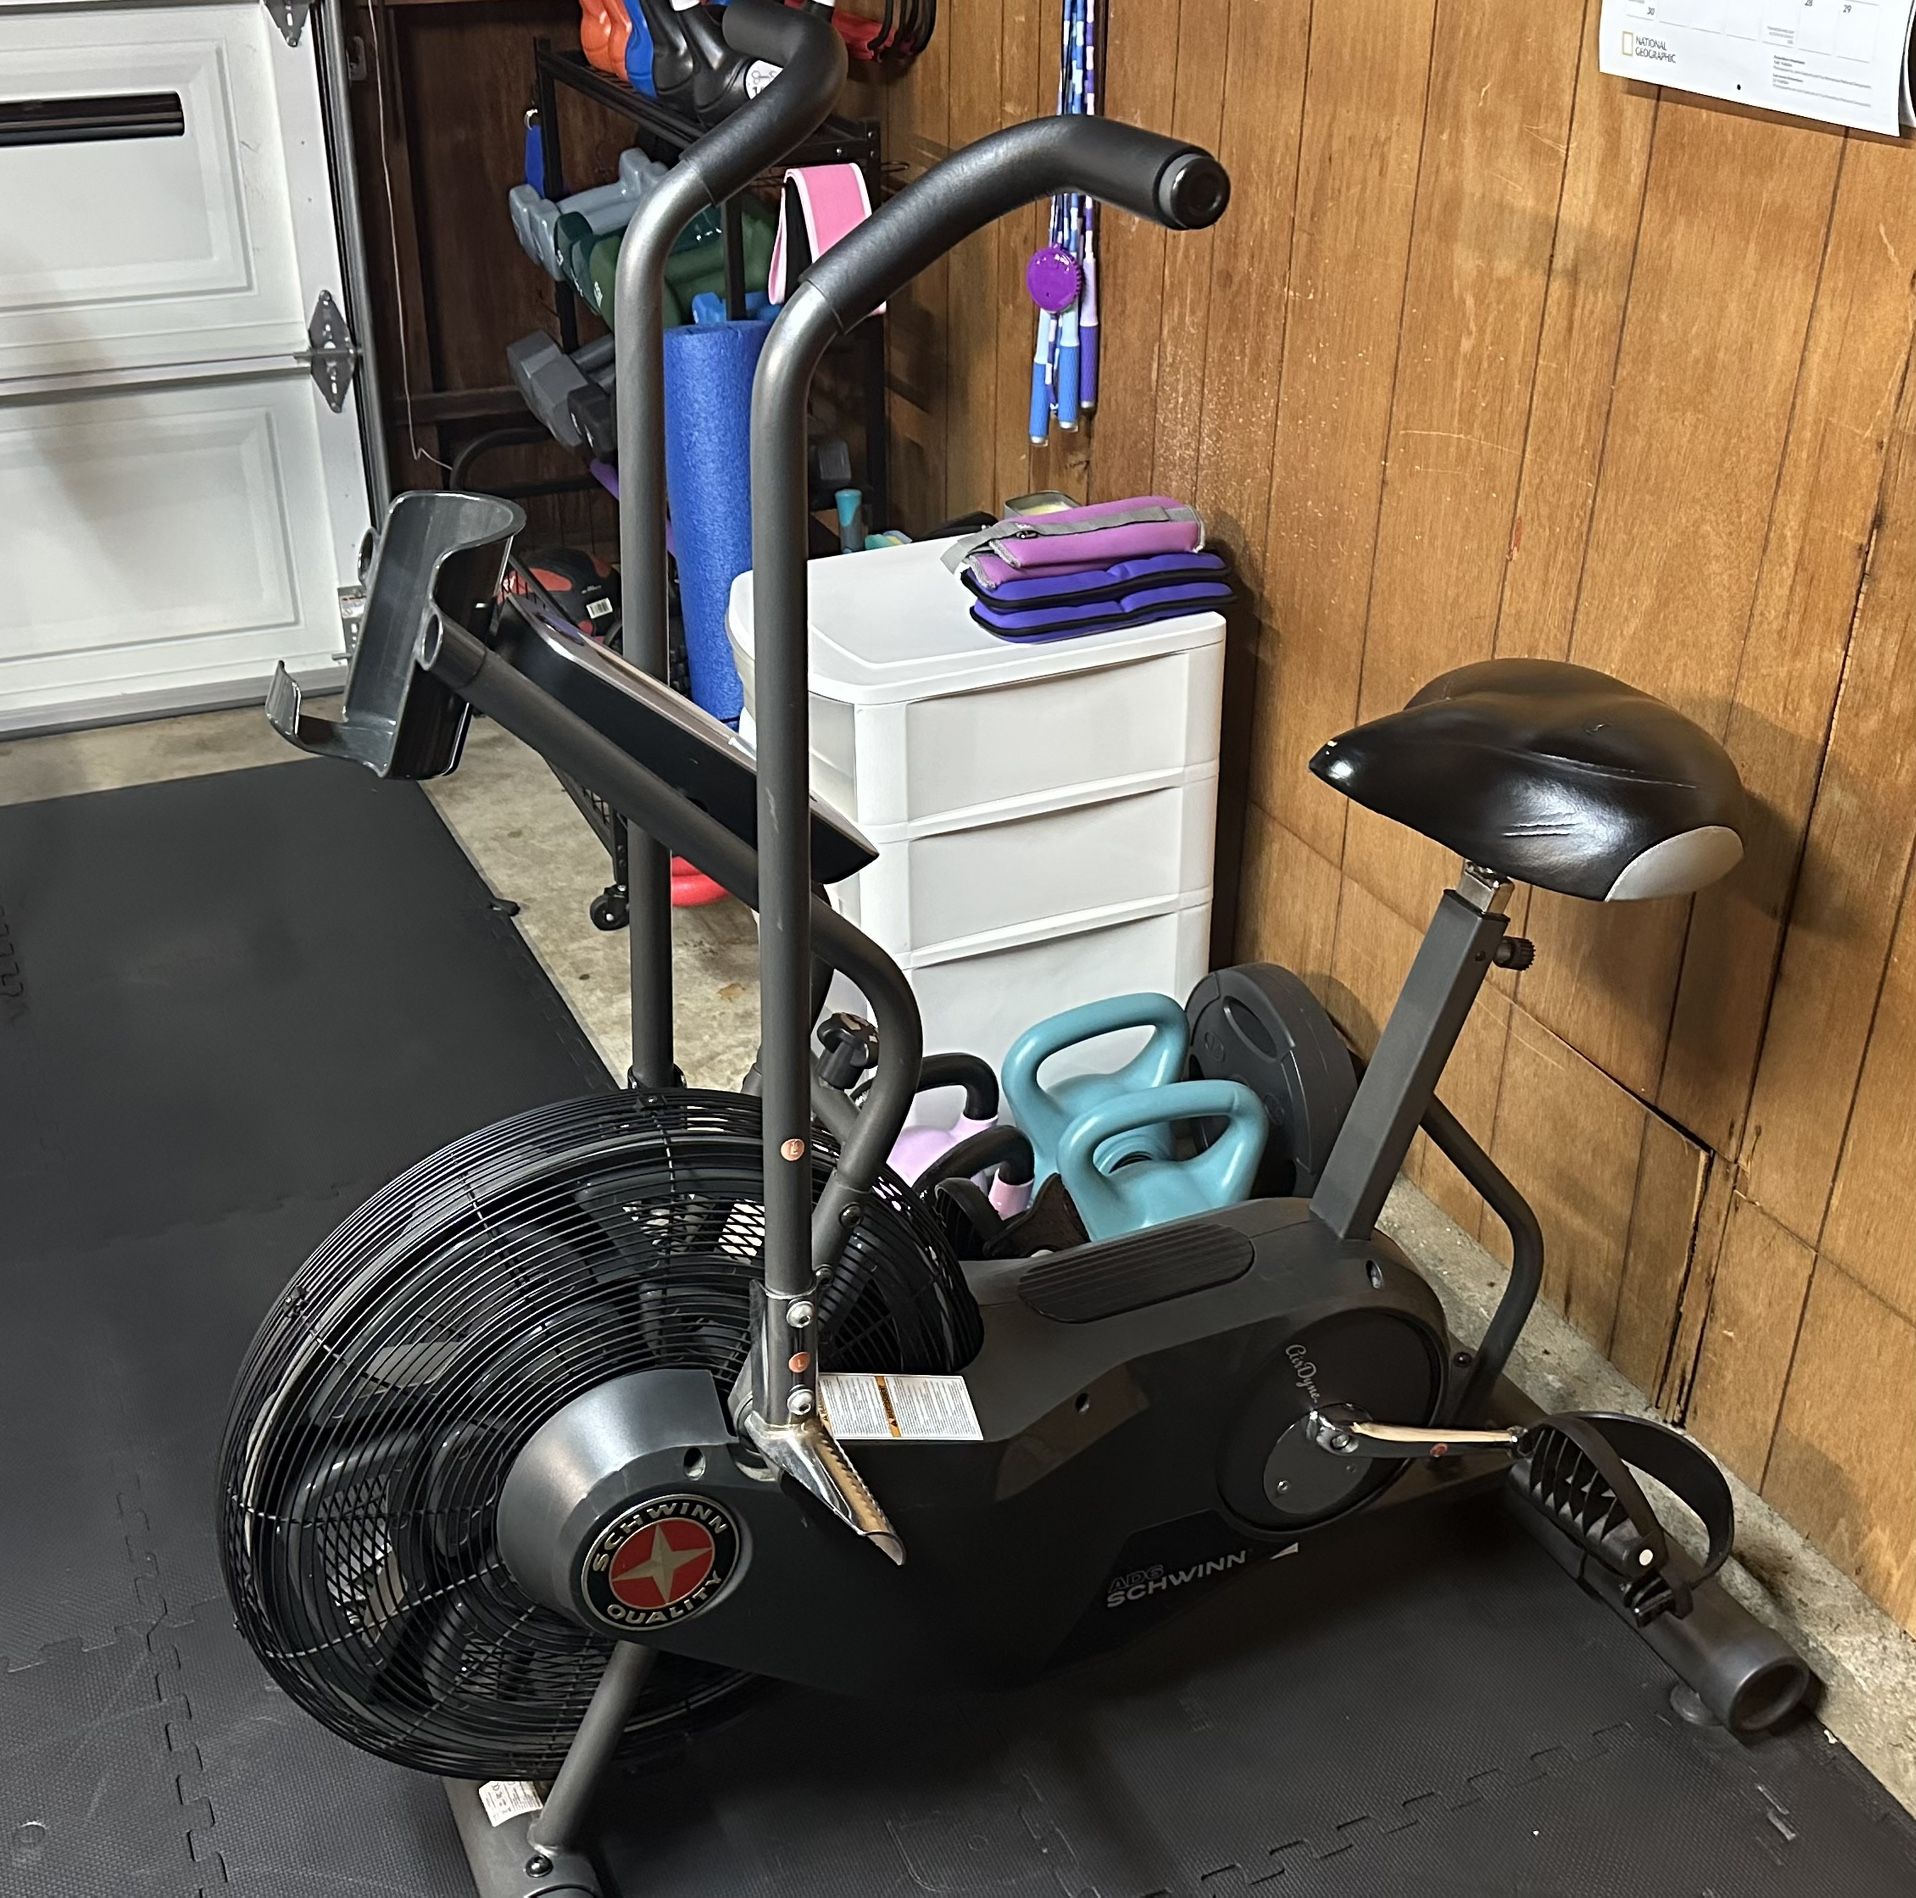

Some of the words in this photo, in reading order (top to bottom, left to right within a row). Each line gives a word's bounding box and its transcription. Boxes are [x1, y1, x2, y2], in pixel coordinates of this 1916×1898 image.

[1647, 6, 1656, 16] 30
[1843, 4, 1852, 13] 29
[1635, 35, 1667, 51] NATIONAL
[1635, 46, 1677, 64] GEOGRAPHIC
[1285, 1344, 1320, 1401] AirDyne
[592, 1502, 728, 1572] SCHWINN
[1107, 1550, 1248, 1608] SCHWINN
[606, 1570, 722, 1625] QUALITY
